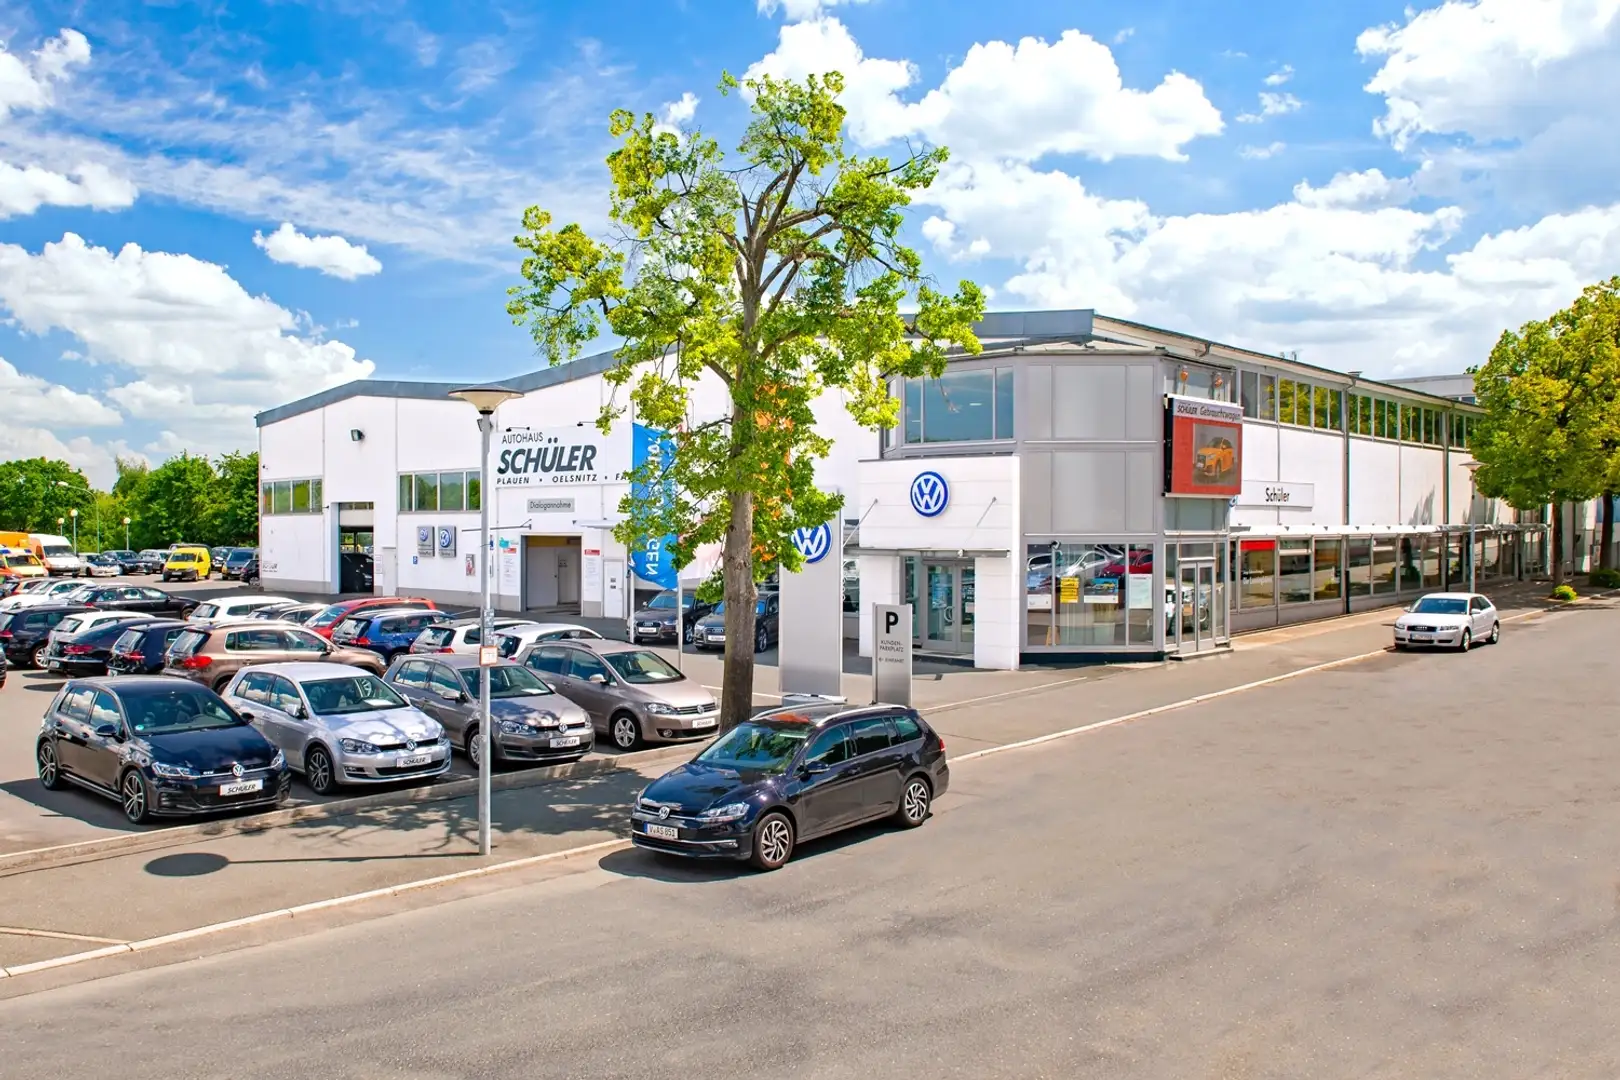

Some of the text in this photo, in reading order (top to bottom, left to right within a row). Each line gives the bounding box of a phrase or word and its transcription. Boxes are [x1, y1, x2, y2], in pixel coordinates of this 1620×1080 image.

[1177, 404, 1241, 422] SCHÜLER Gebrauchtwagen
[502, 432, 544, 445] AUTOHAUS
[497, 437, 597, 475] SCHÜLER
[497, 477, 530, 485] PLAUEN
[552, 474, 598, 483] OELSNITZ
[1265, 487, 1290, 503] Schüler
[530, 501, 572, 511] Dialogannahme
[886, 611, 899, 634] P
